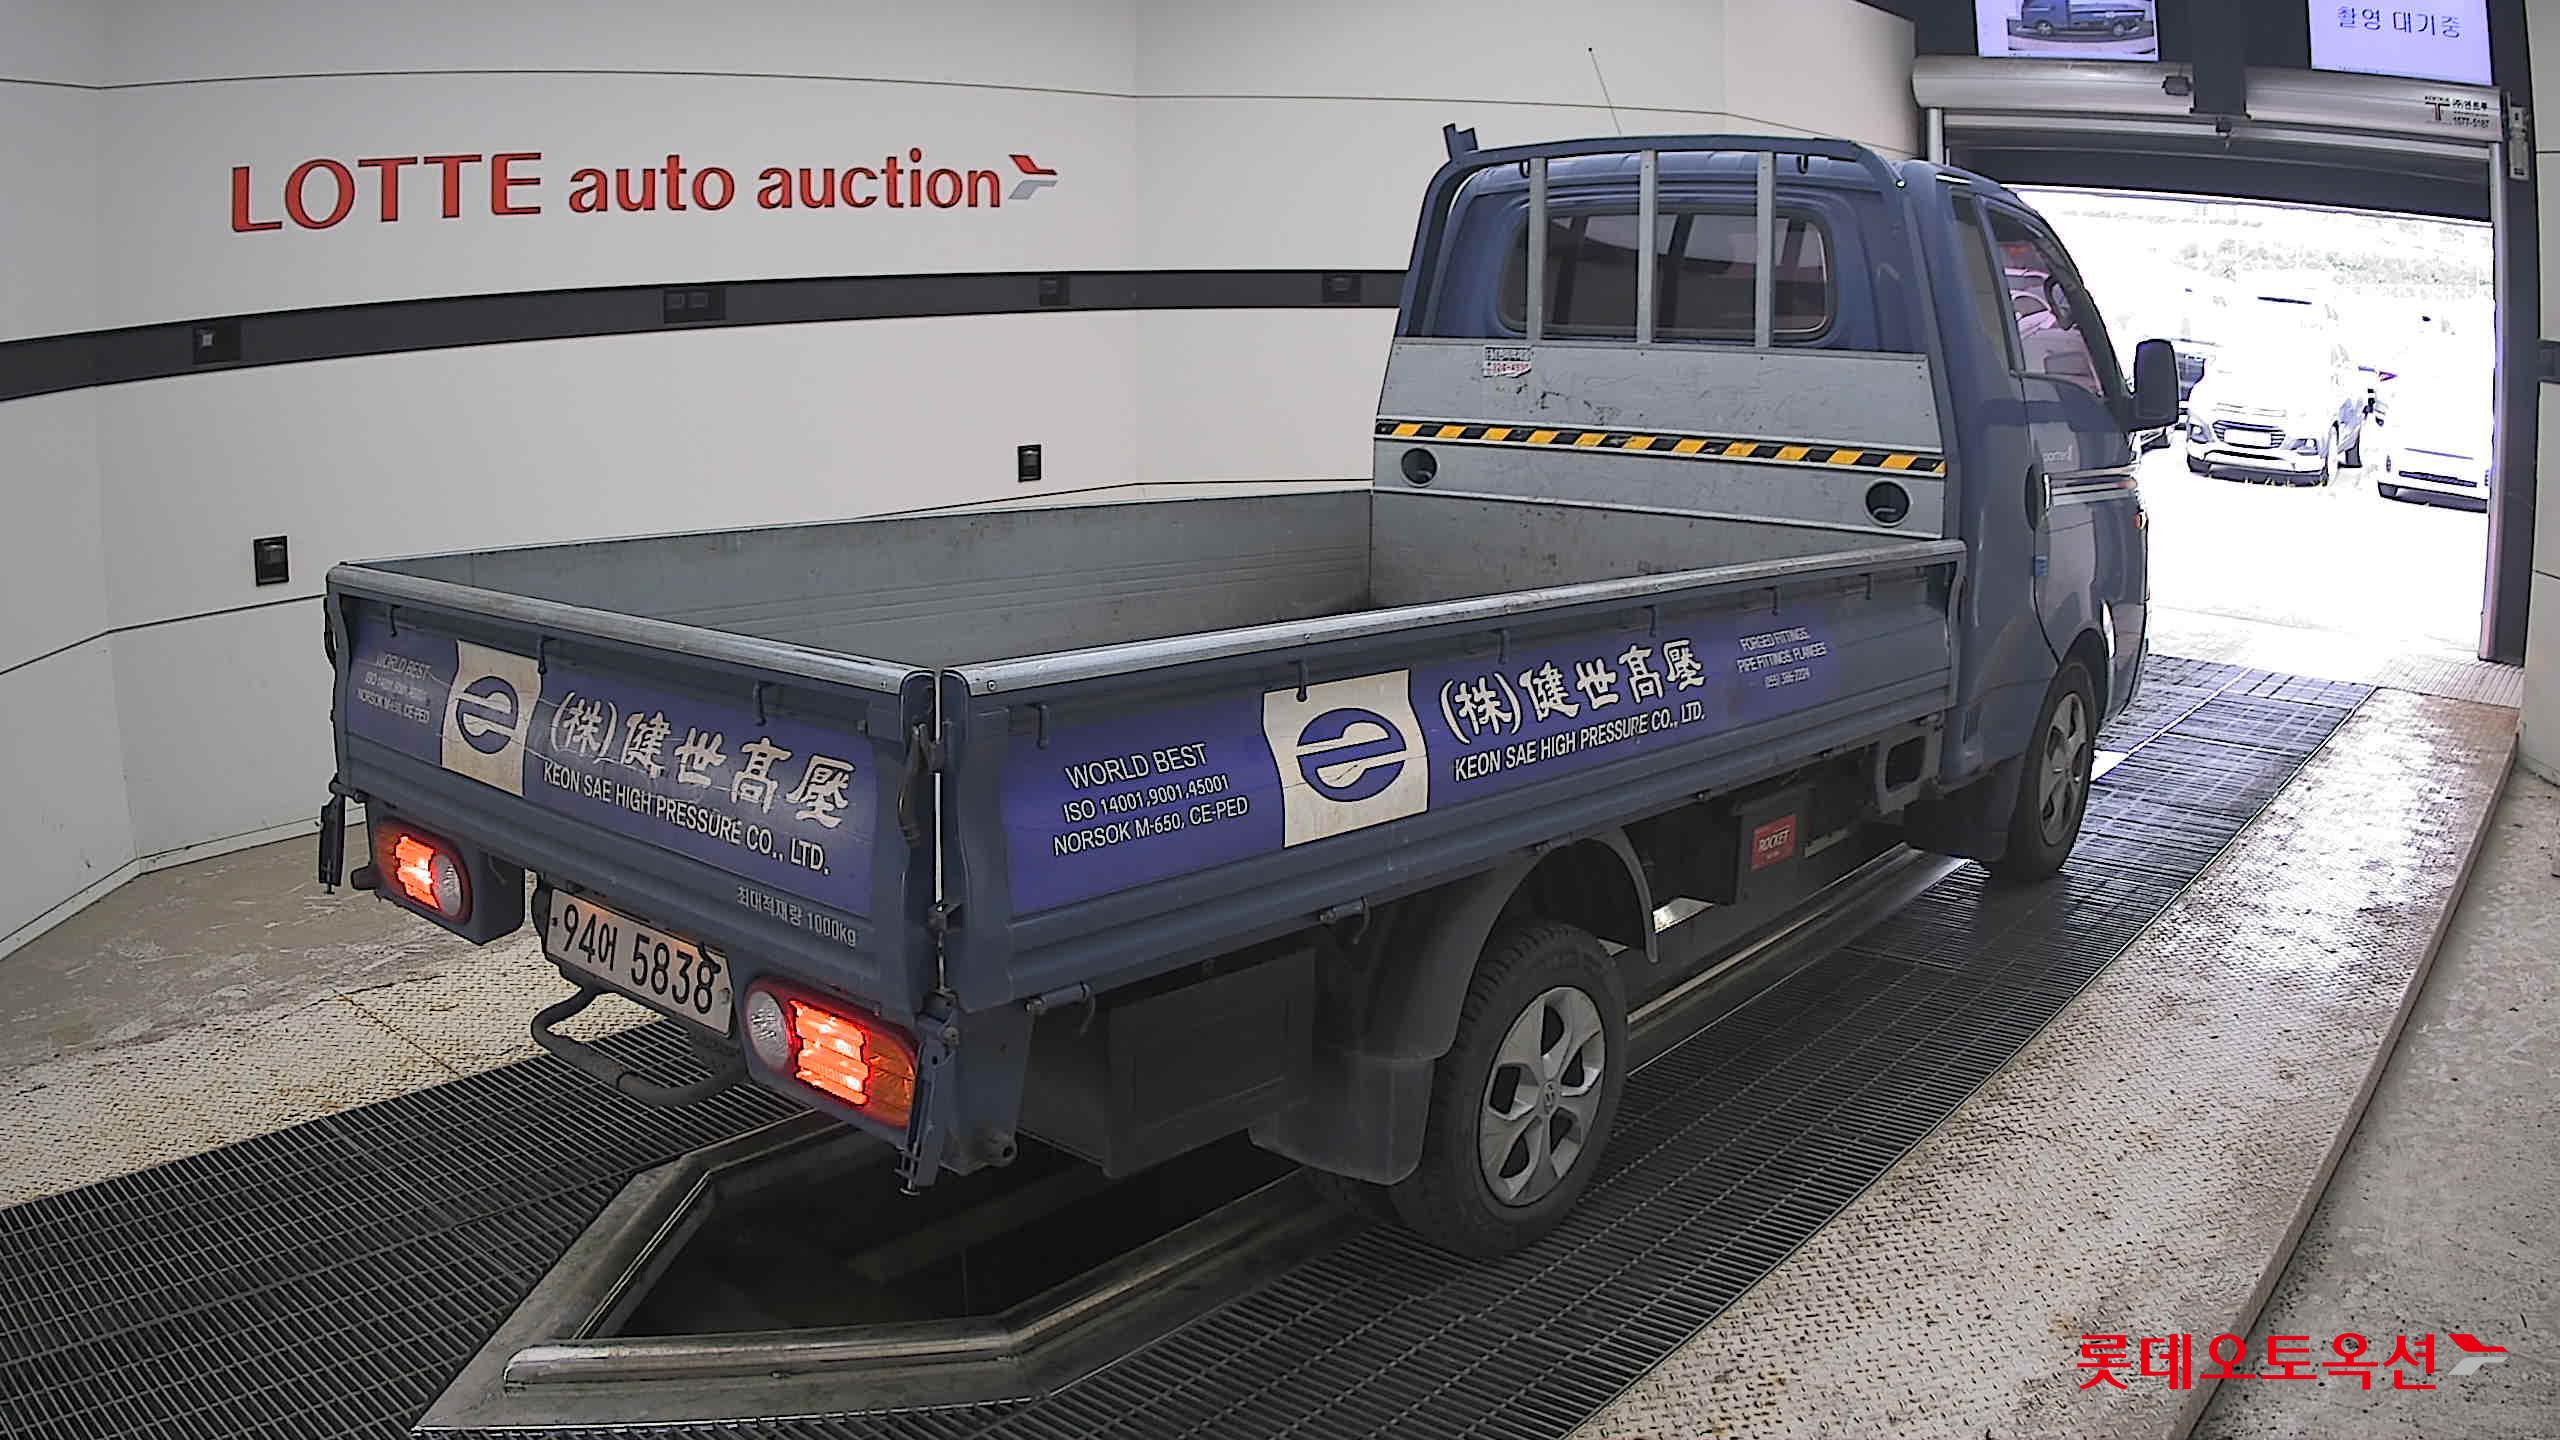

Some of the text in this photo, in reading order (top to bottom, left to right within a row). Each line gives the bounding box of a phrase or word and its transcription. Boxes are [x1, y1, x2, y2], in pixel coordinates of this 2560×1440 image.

[2337, 6, 2461, 38] 촬영 대기중
[232, 147, 1001, 233] LOTTE auto auction
[1736, 657, 1759, 673] PIPE
[1065, 743, 1208, 790] WORLD BEST
[1454, 749, 1501, 782] KEON
[1505, 741, 1537, 769] SAE
[1540, 730, 1577, 760] HIGH
[1580, 713, 1649, 750] PRESSURE
[1681, 700, 1706, 724] LTD.
[543, 761, 580, 792] KEON
[583, 774, 612, 803] SAE
[615, 783, 651, 816] HIGH
[655, 797, 742, 844] PRESSURE
[790, 838, 832, 876] LTD.
[1053, 796, 1249, 856] NORSOK M-650, CE-PED
[1063, 799, 1096, 824] ISO
[1759, 829, 1791, 853] ROCKET
[736, 886, 857, 948] 최대적재량 1000kg
[563, 903, 714, 1015] 94어 5838
